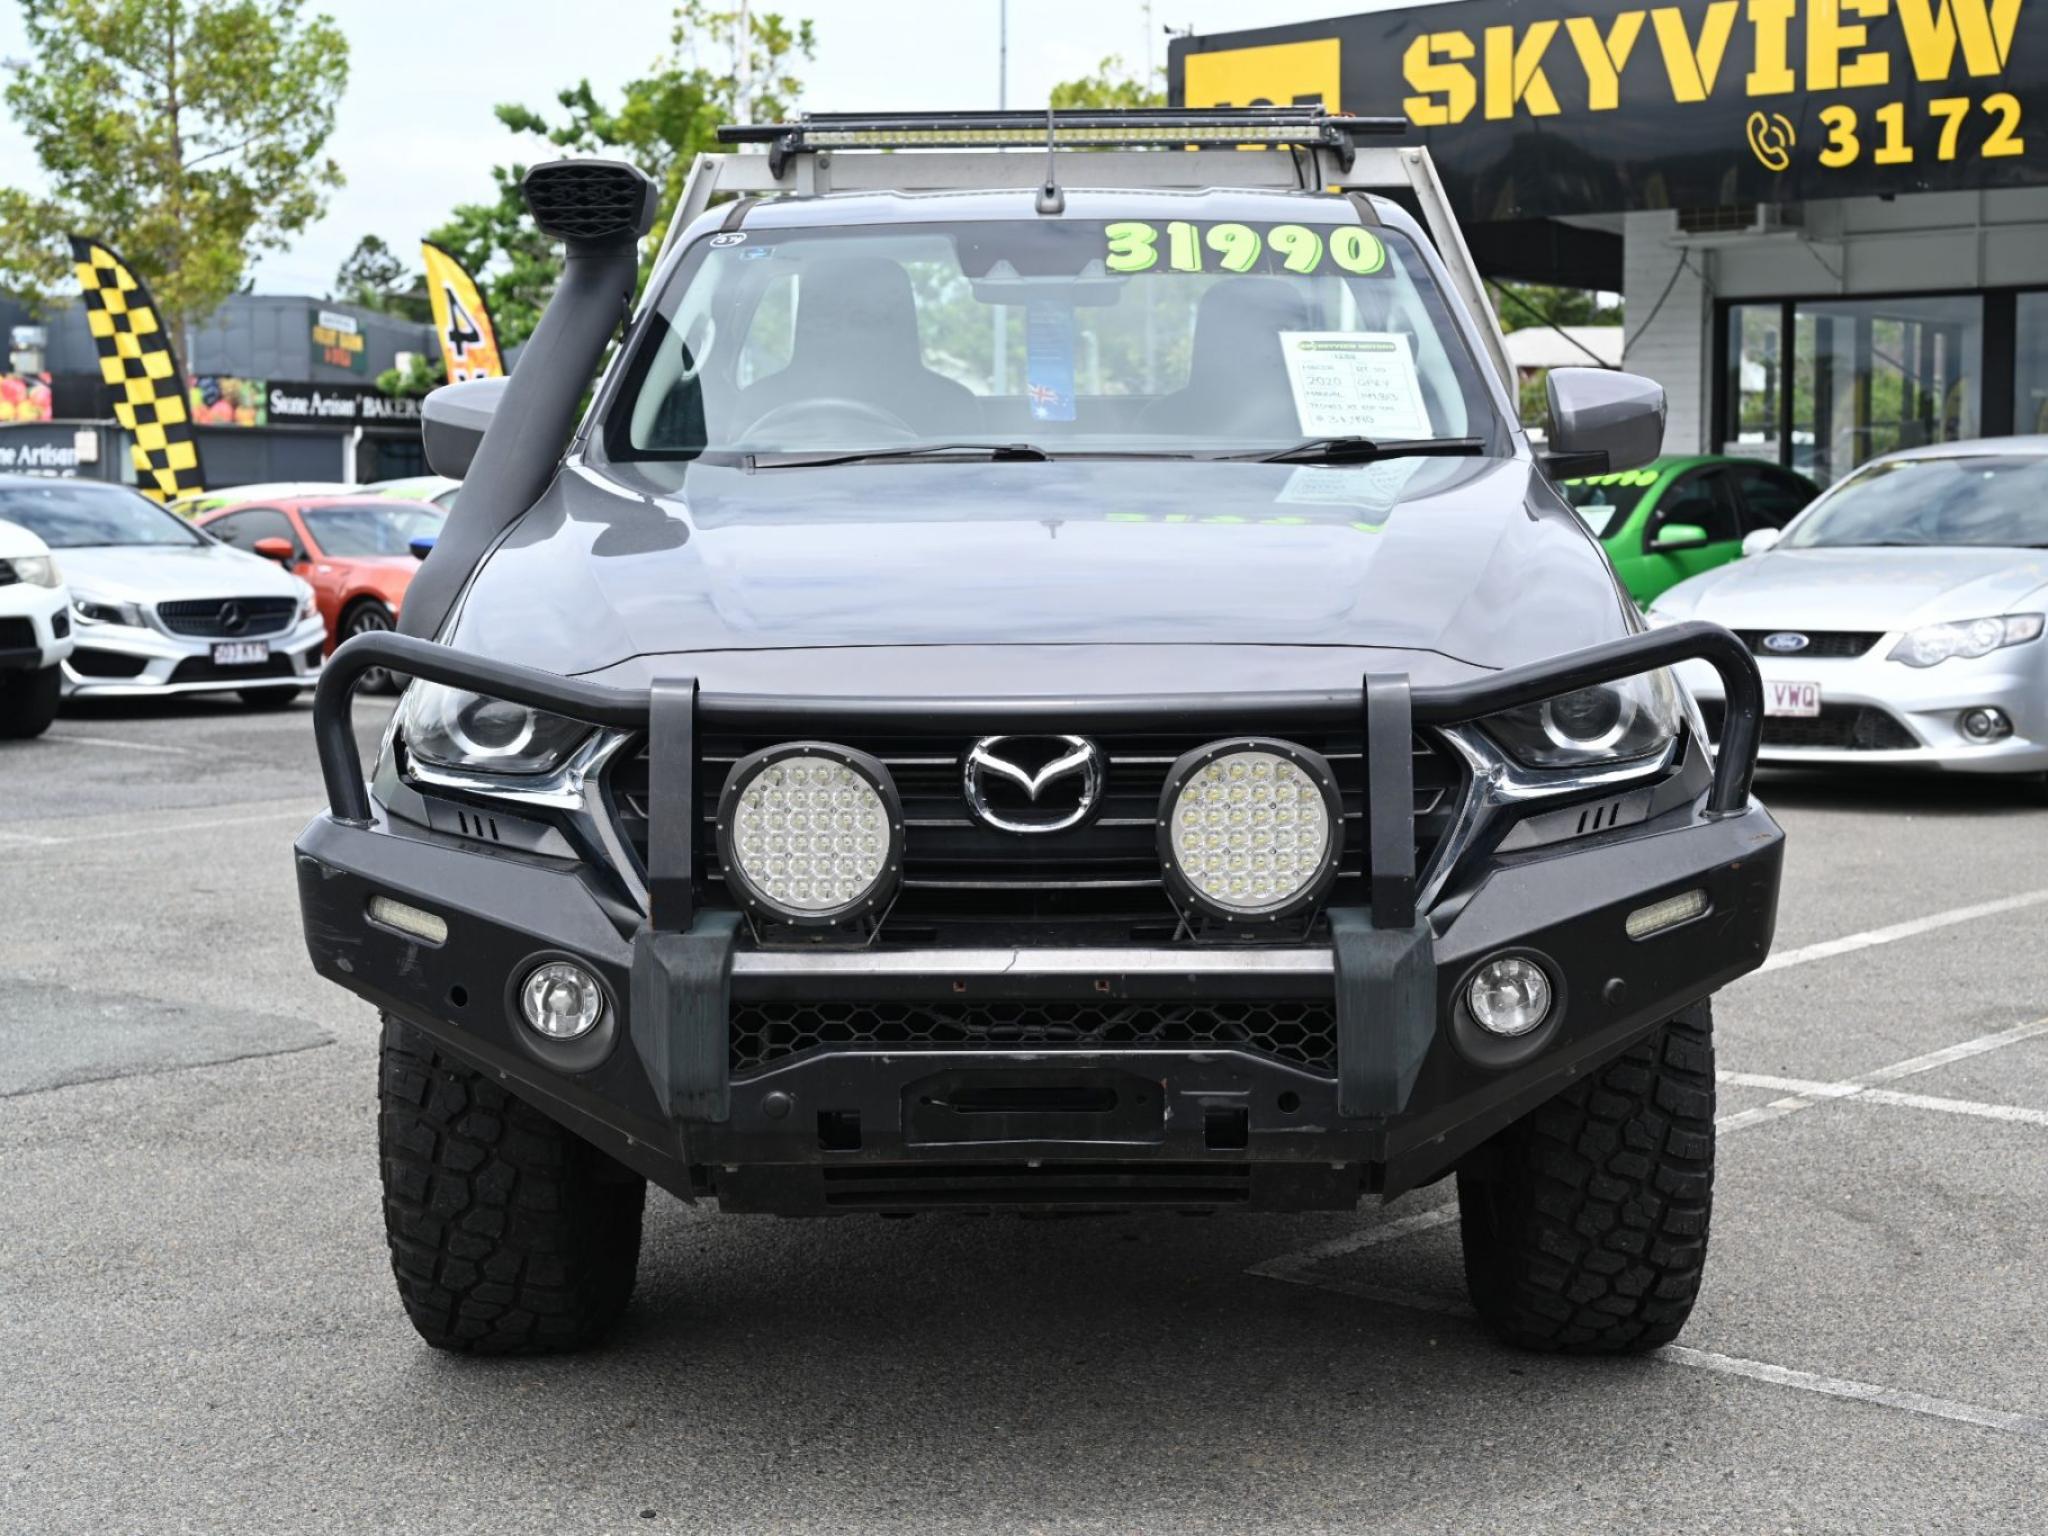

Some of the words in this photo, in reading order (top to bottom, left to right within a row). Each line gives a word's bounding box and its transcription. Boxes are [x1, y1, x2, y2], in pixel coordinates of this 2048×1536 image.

[1402, 0, 2022, 127] SKYVIEW
[1818, 93, 2024, 167] 3172
[1105, 221, 1386, 274] 31990
[271, 389, 308, 415] Stone
[310, 391, 356, 417] Artisan
[1774, 684, 1815, 708] VWQ
